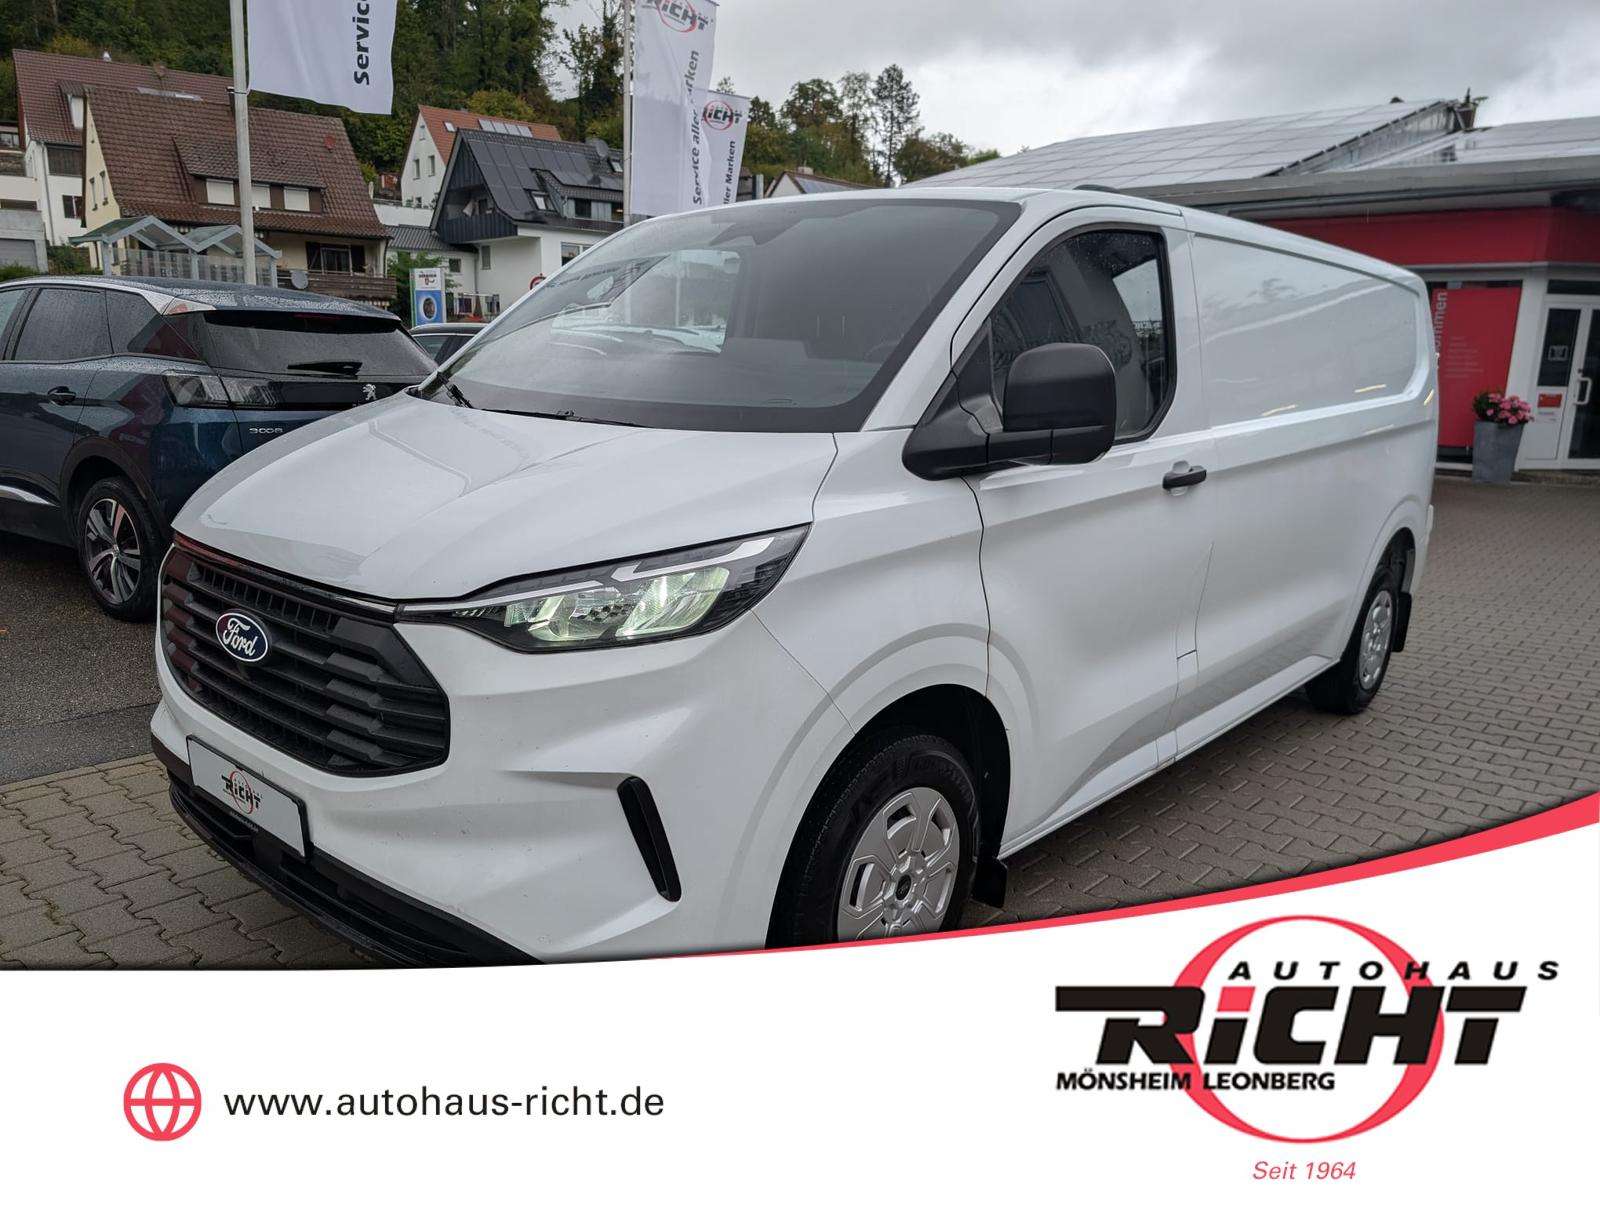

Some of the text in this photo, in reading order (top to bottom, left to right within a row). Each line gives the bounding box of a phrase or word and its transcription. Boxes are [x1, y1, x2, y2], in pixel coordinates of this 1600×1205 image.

[352, 0, 370, 85] Servic
[725, 140, 736, 185] Marken
[223, 618, 258, 656] Ford
